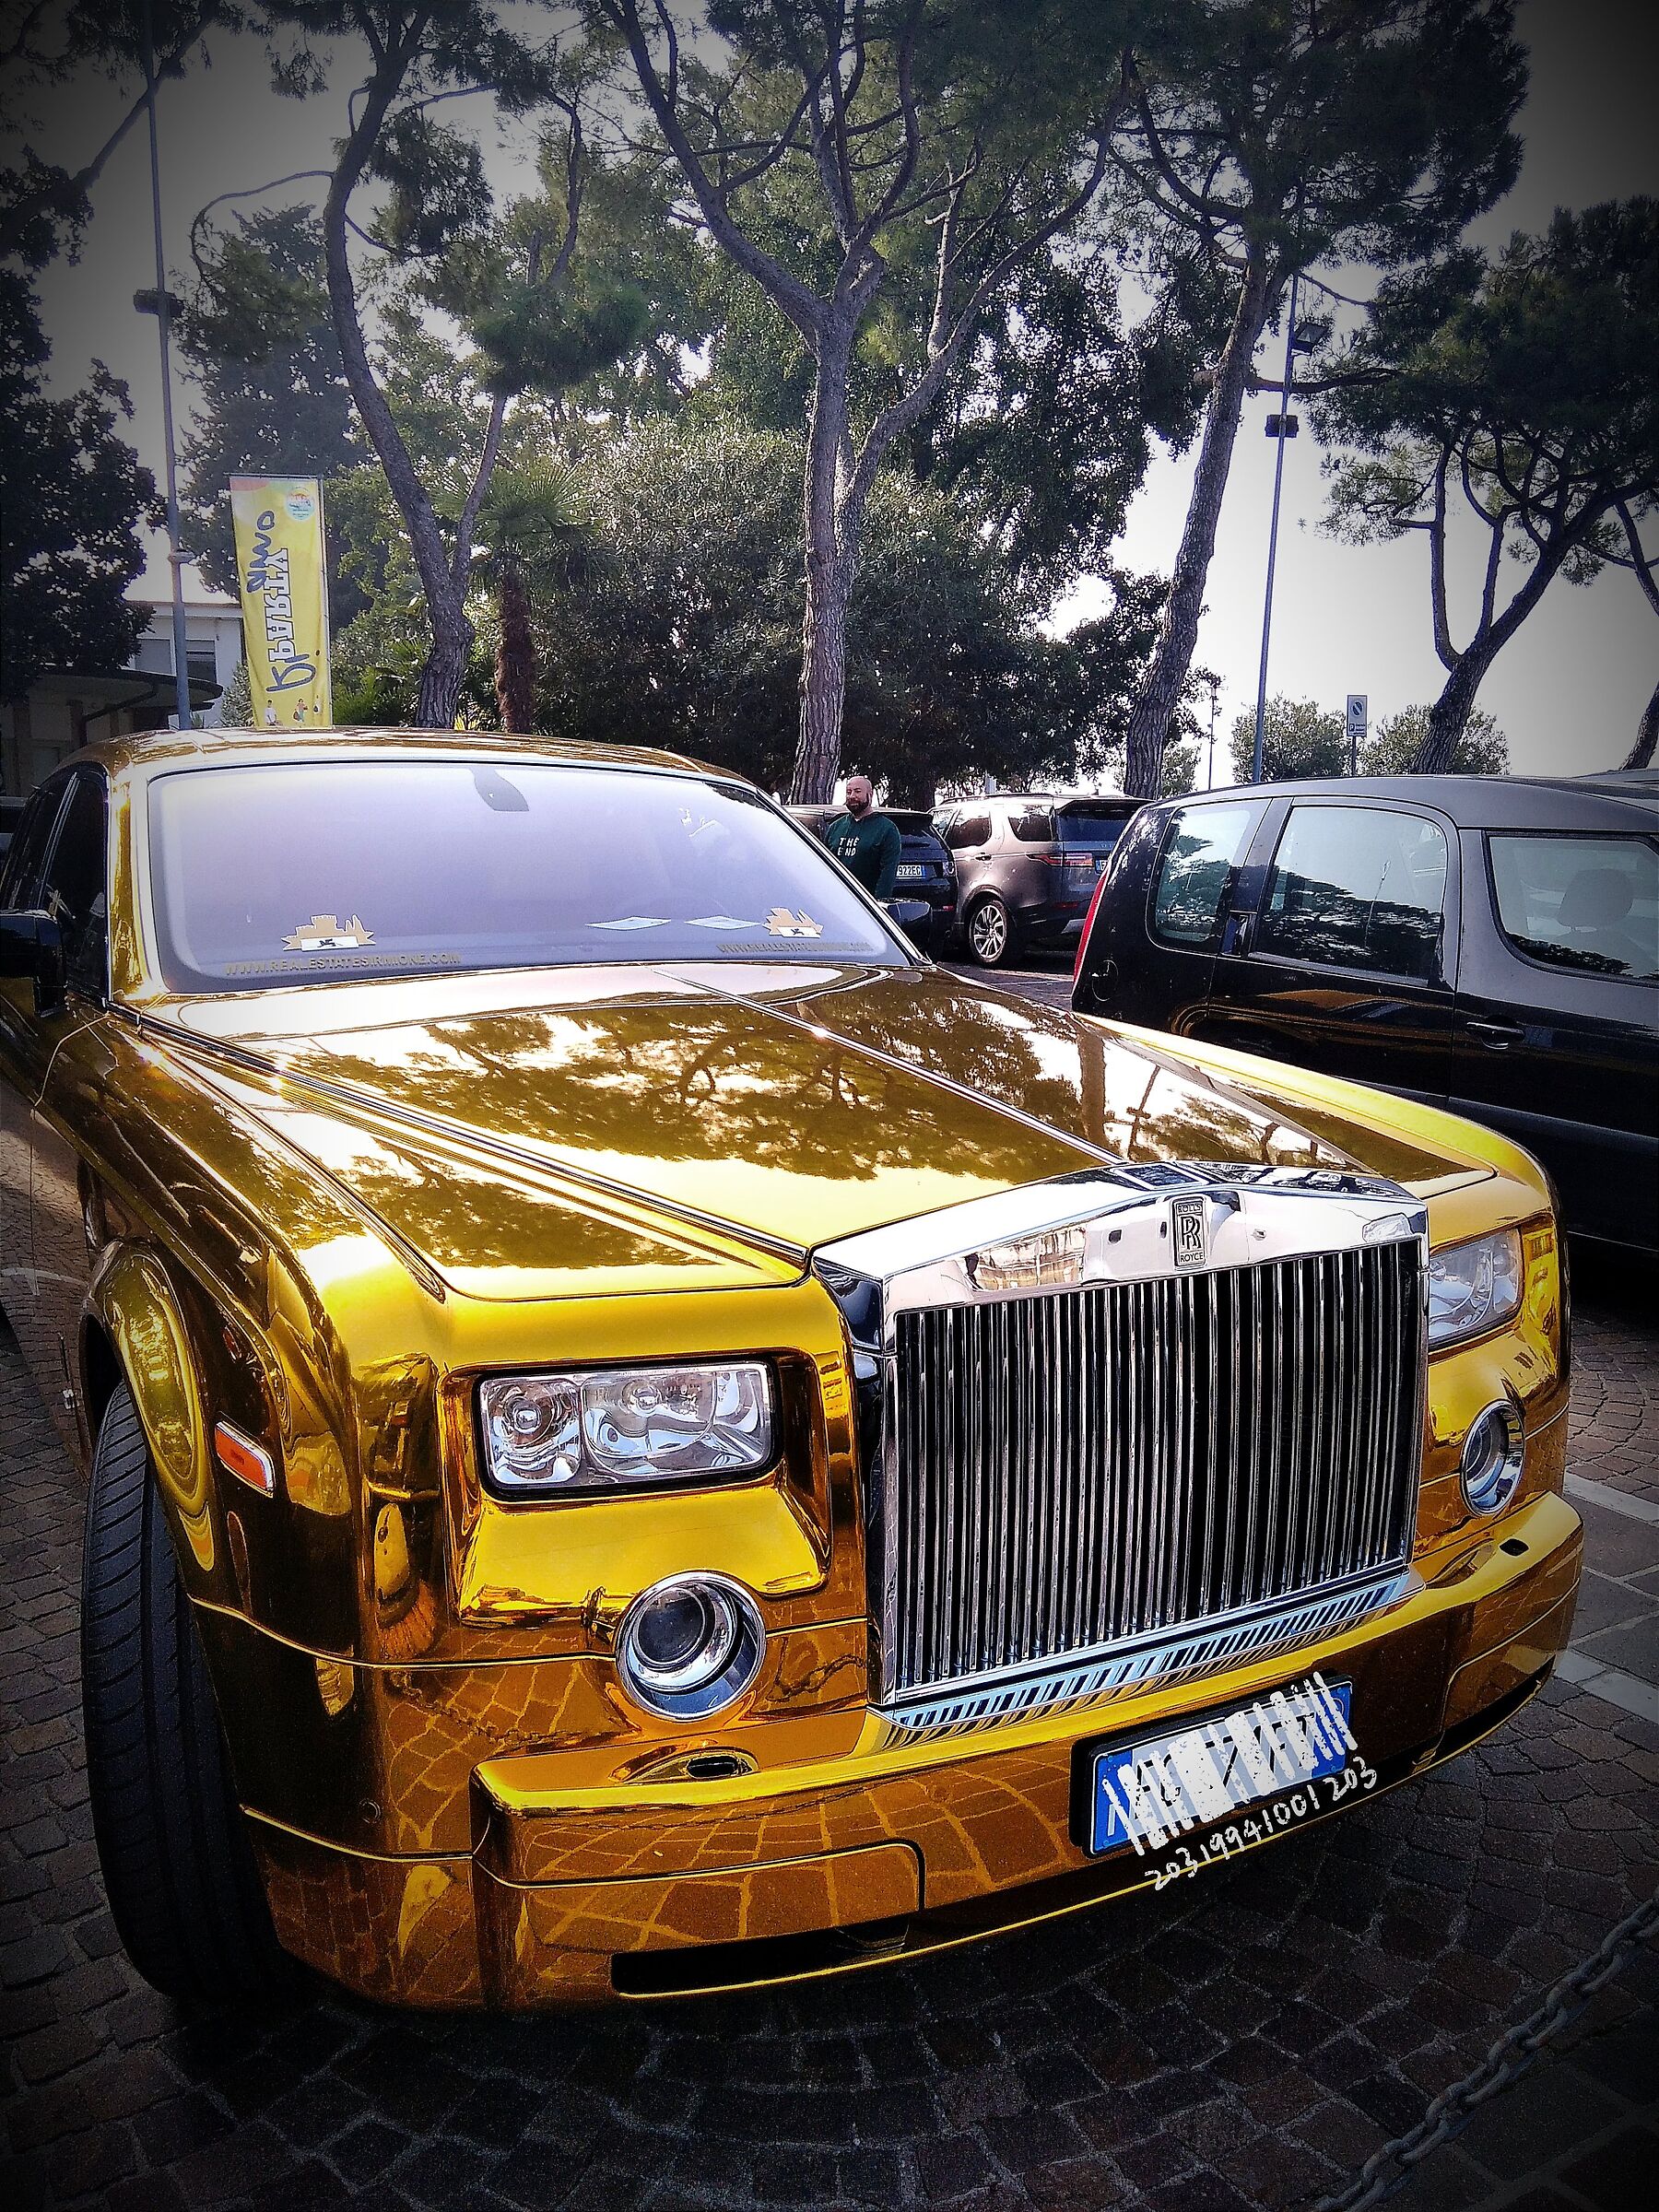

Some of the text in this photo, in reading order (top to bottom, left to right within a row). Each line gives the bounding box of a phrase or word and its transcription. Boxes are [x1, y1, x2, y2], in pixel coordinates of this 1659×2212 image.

[839, 836, 860, 847] THE
[837, 847, 856, 856] END
[1177, 1203, 1201, 1213] ROLLS
[1180, 1253, 1204, 1263] ROYCE
